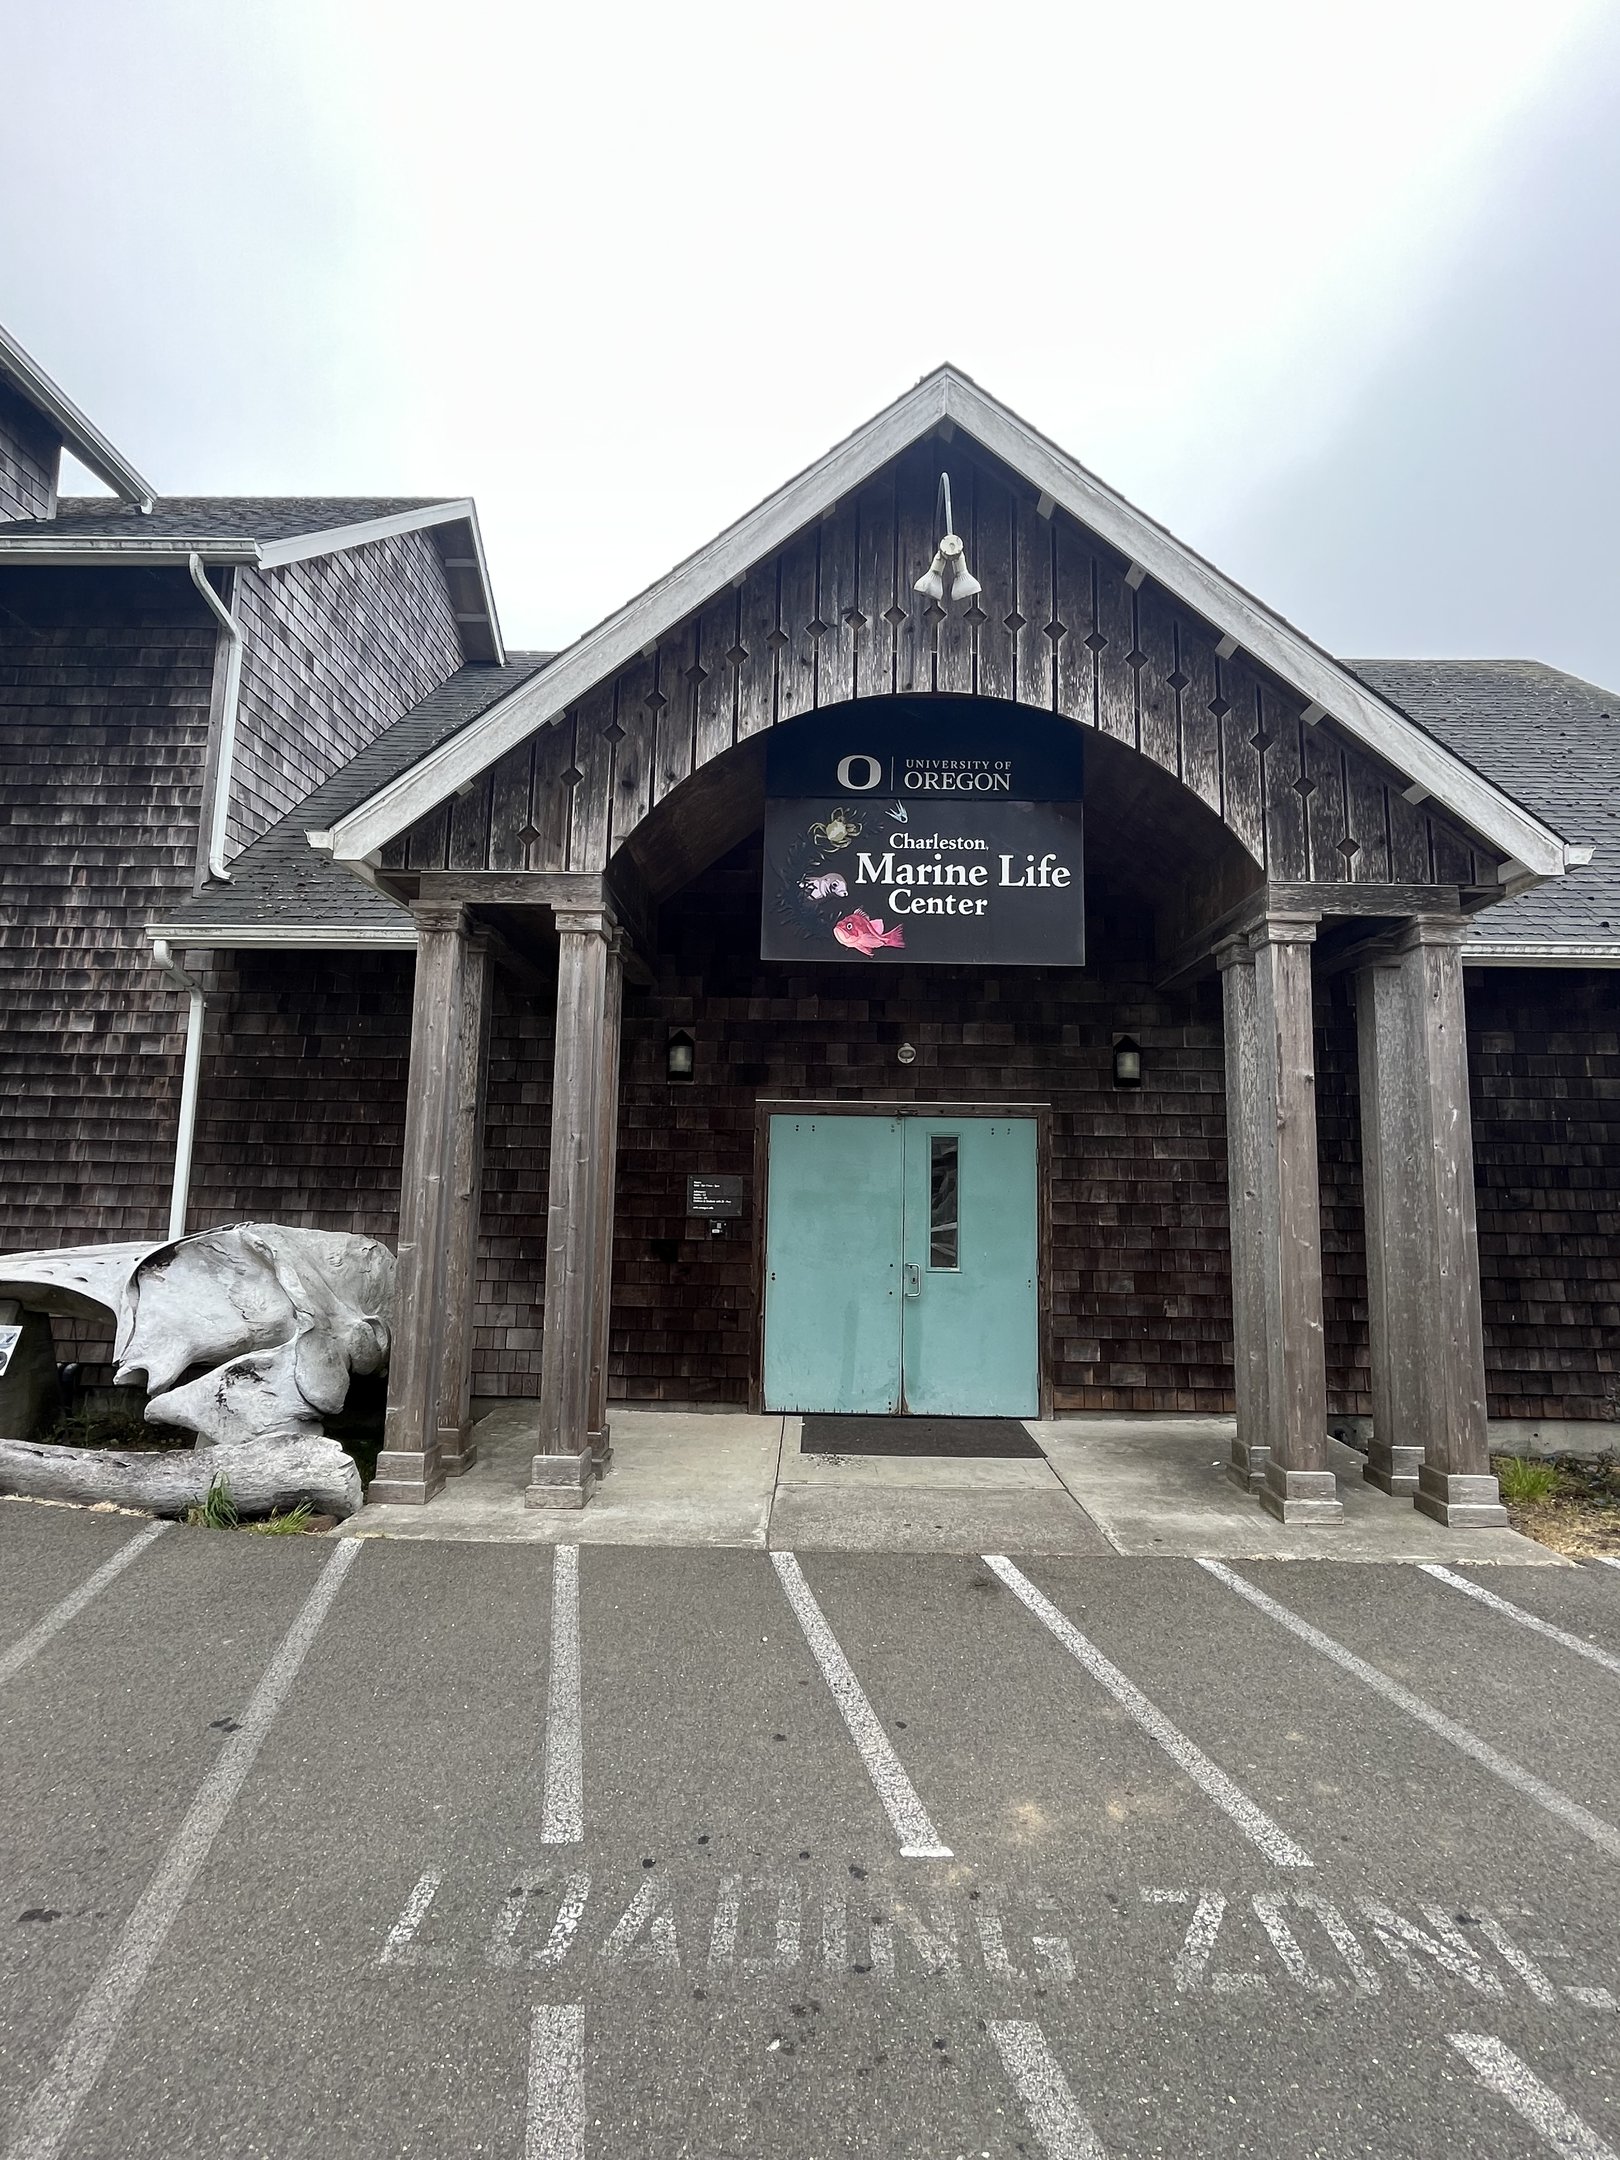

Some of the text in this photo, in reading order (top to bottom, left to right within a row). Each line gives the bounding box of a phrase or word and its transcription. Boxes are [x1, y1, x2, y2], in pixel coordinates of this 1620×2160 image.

[837, 755, 882, 790] O
[906, 759, 1012, 770] UNIVERSITY OF
[904, 771, 1012, 791] OREGON
[855, 852, 1071, 887] Marine Life
[888, 888, 988, 915] Center
